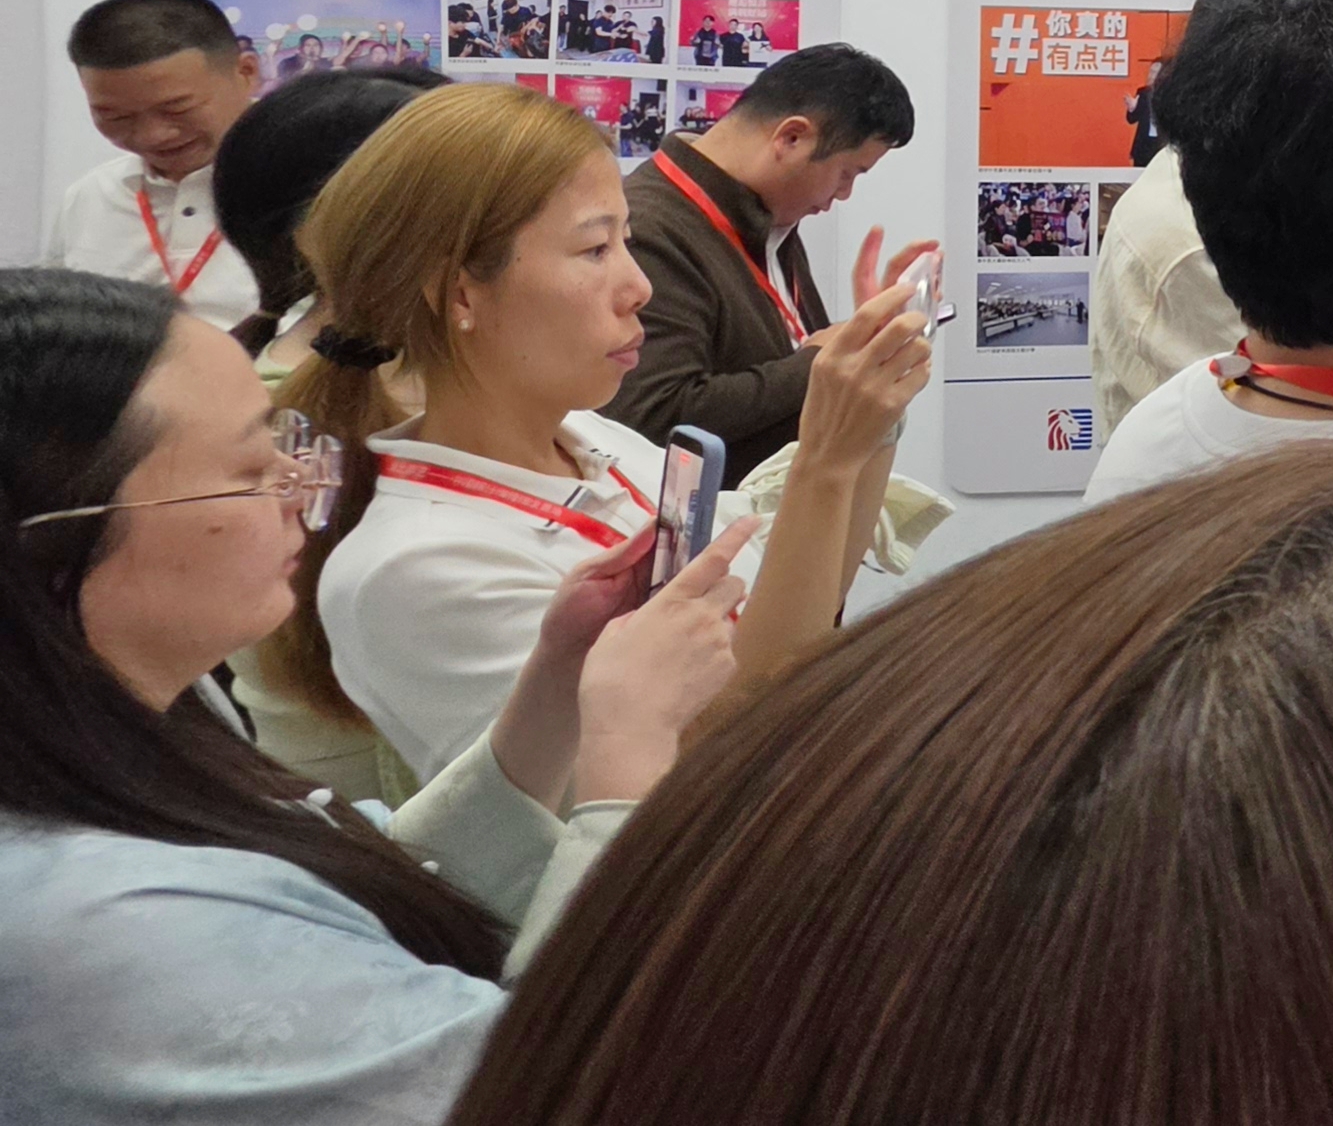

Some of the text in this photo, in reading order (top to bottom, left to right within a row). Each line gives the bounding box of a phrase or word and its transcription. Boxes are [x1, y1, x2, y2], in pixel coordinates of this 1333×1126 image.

[1045, 11, 1128, 39] 你真的
[1047, 42, 1126, 72] 有点牛
